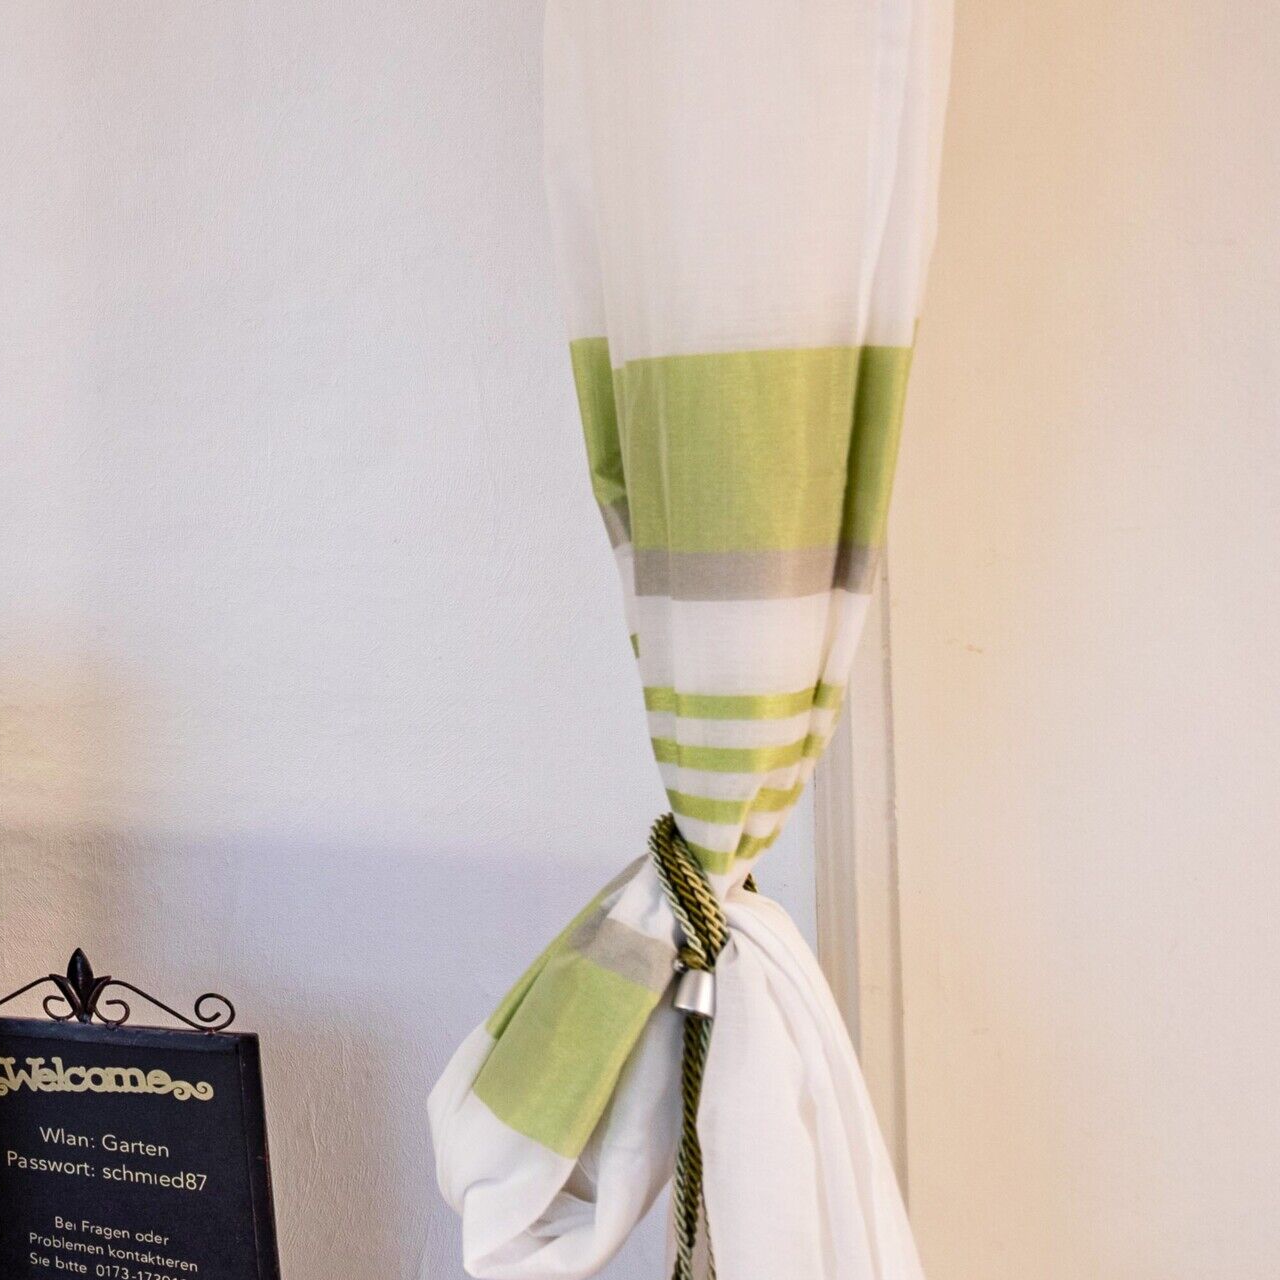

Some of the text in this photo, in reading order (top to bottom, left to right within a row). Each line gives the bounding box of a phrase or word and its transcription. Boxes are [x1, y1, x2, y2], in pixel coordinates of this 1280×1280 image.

[39, 1126, 170, 1158] Wlan: Garten
[6, 1150, 208, 1191] Passwort: schmied87
[54, 1216, 170, 1246] Bei Fragen oder
[28, 1232, 199, 1272] Problemen kontaktieren
[29, 1252, 51, 1267] Sie
[55, 1257, 88, 1275] bitte
